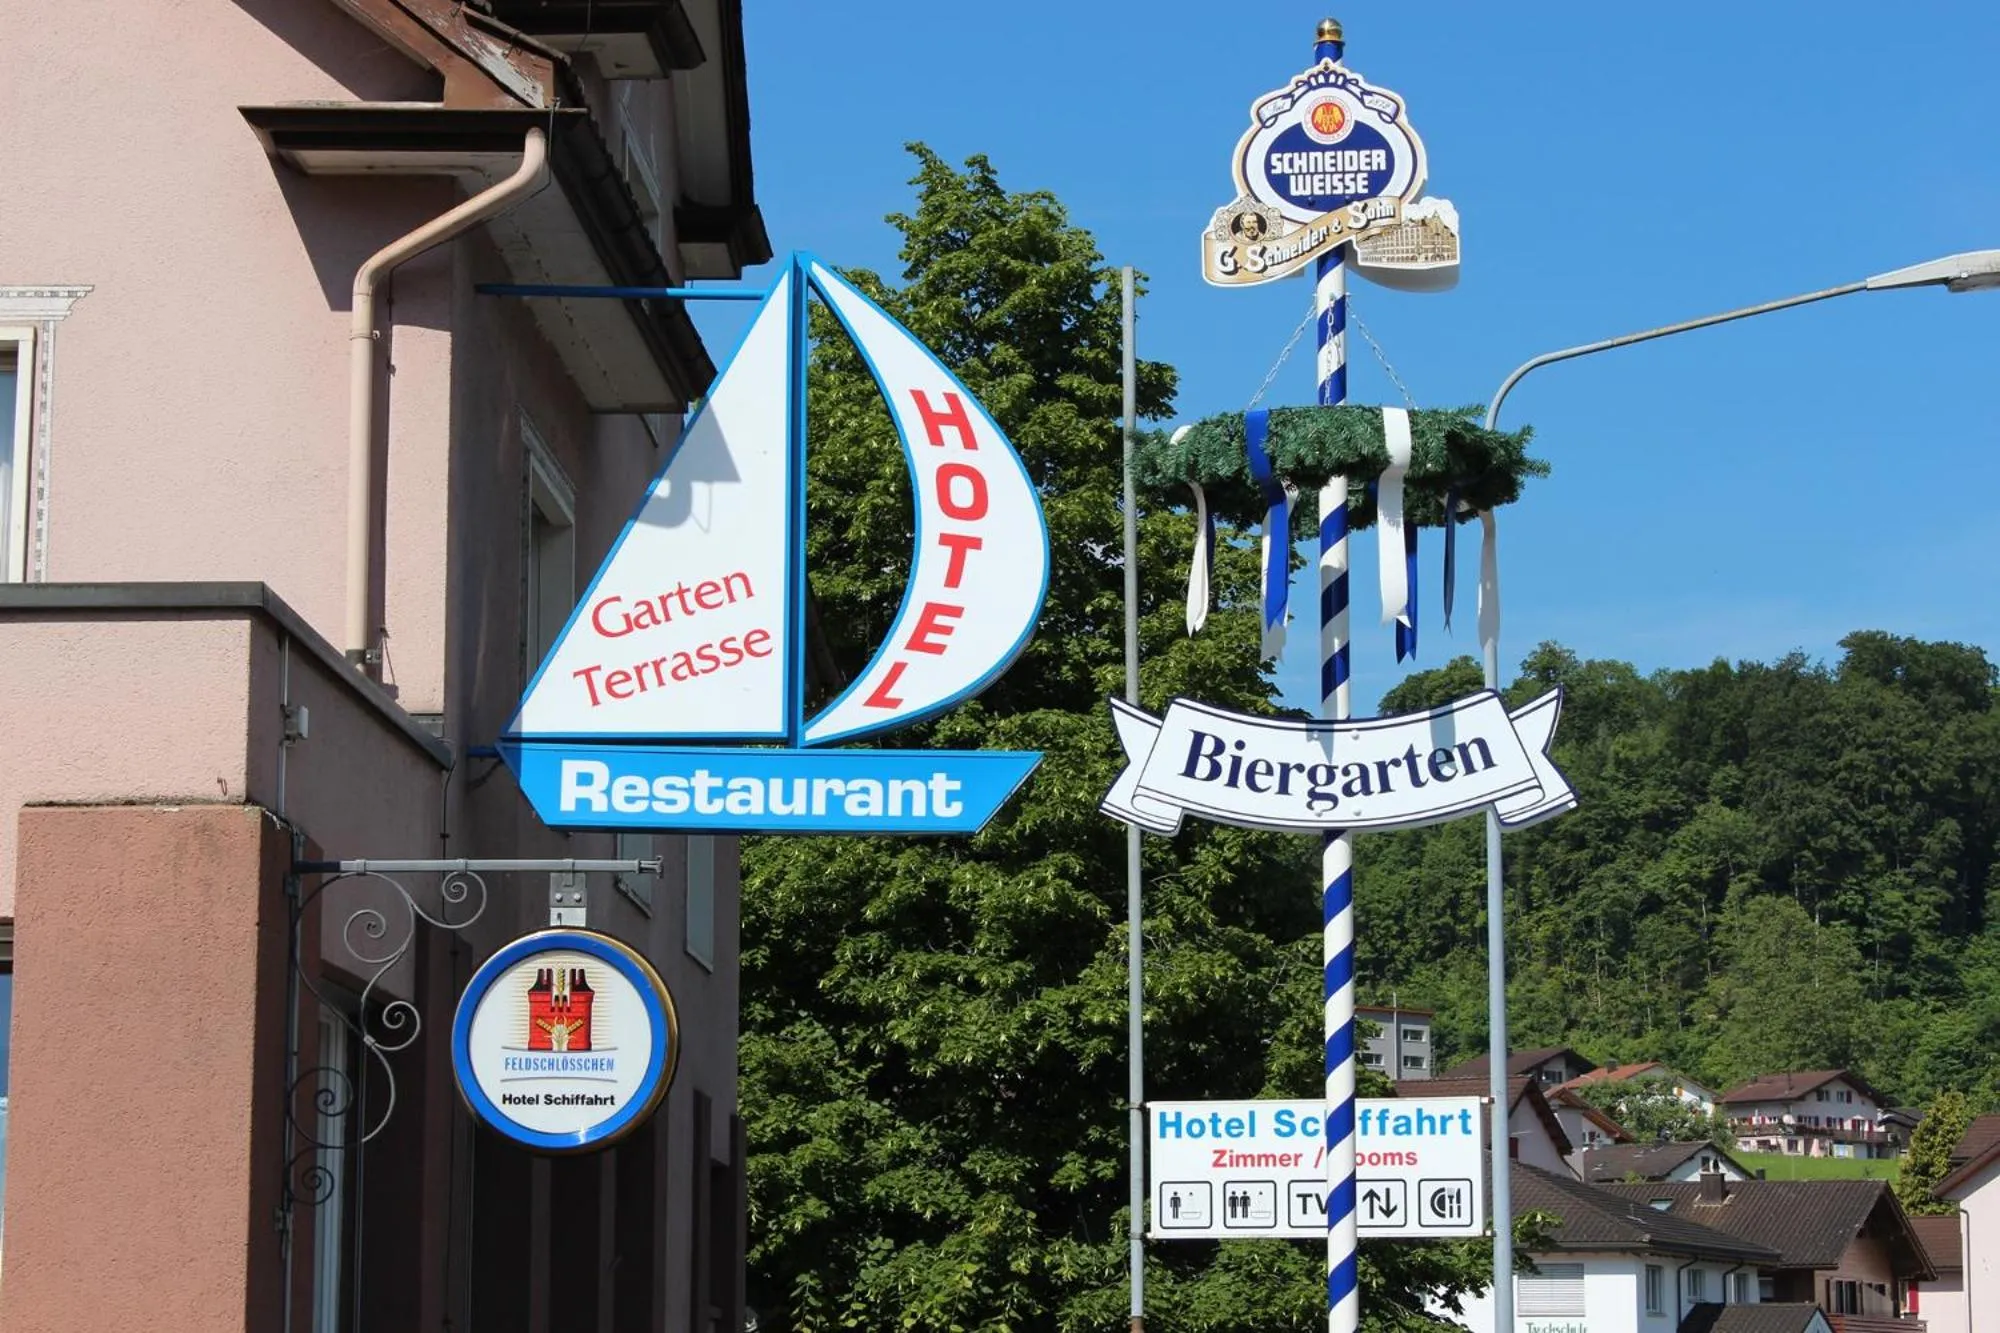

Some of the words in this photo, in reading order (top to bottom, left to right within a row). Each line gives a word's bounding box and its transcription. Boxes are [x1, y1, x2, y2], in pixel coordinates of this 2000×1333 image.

[1271, 149, 1387, 174] SCHNEIDER
[1289, 172, 1369, 196] WEISSE
[1246, 227, 1330, 274] Schneider
[1331, 217, 1343, 234] &
[1347, 201, 1396, 230] Sohn
[863, 389, 989, 710] HOTEL
[591, 571, 755, 638] Garten
[572, 628, 773, 707] Terrasse
[559, 758, 963, 818] Restaurant
[1178, 728, 1499, 811] Biergarten
[504, 1055, 615, 1072] FELDSCHLÖSSCHEN
[502, 1094, 540, 1106] Hotel
[543, 1094, 616, 1106] Schiffahrt
[1158, 1110, 1257, 1138] Hotel
[1273, 1107, 1473, 1138] Scffahrt
[1212, 1149, 1303, 1168] Zimmer
[1355, 1148, 1419, 1167] ooms
